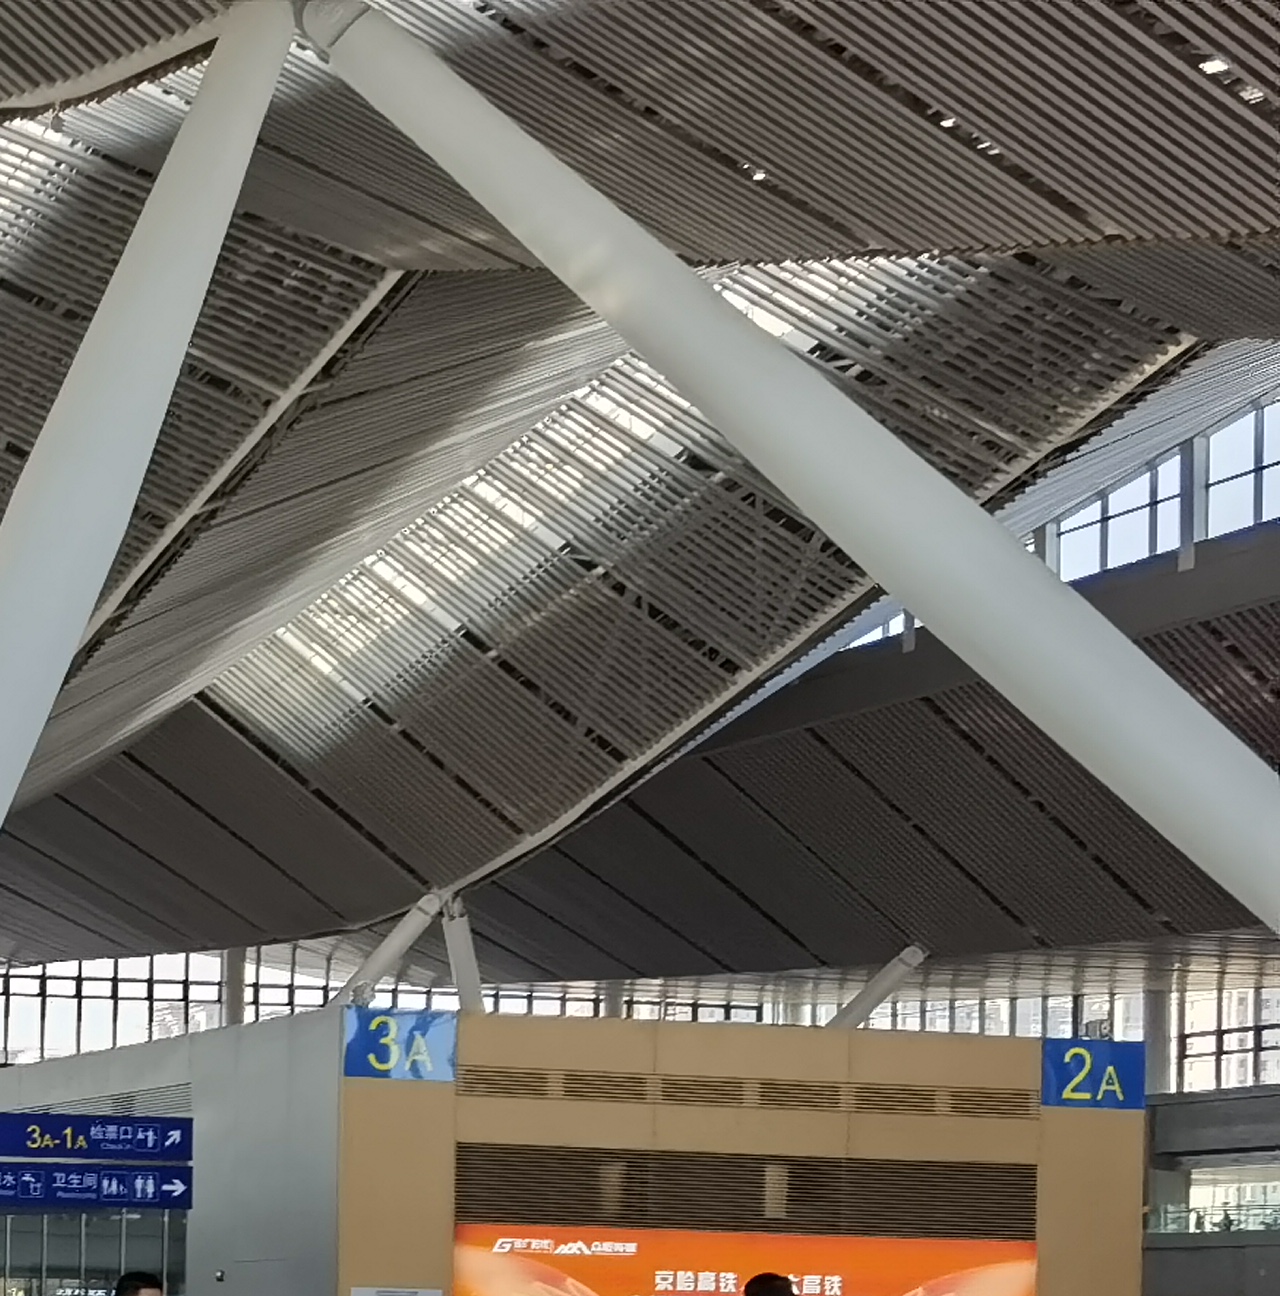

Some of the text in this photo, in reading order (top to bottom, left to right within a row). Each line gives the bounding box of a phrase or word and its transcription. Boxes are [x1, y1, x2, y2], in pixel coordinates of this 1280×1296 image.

[367, 1016, 433, 1073] 3A
[1060, 1047, 1124, 1103] 2A
[25, 1124, 133, 1149] 3A-1A 检票口
[52, 1172, 98, 1189] 卫生间
